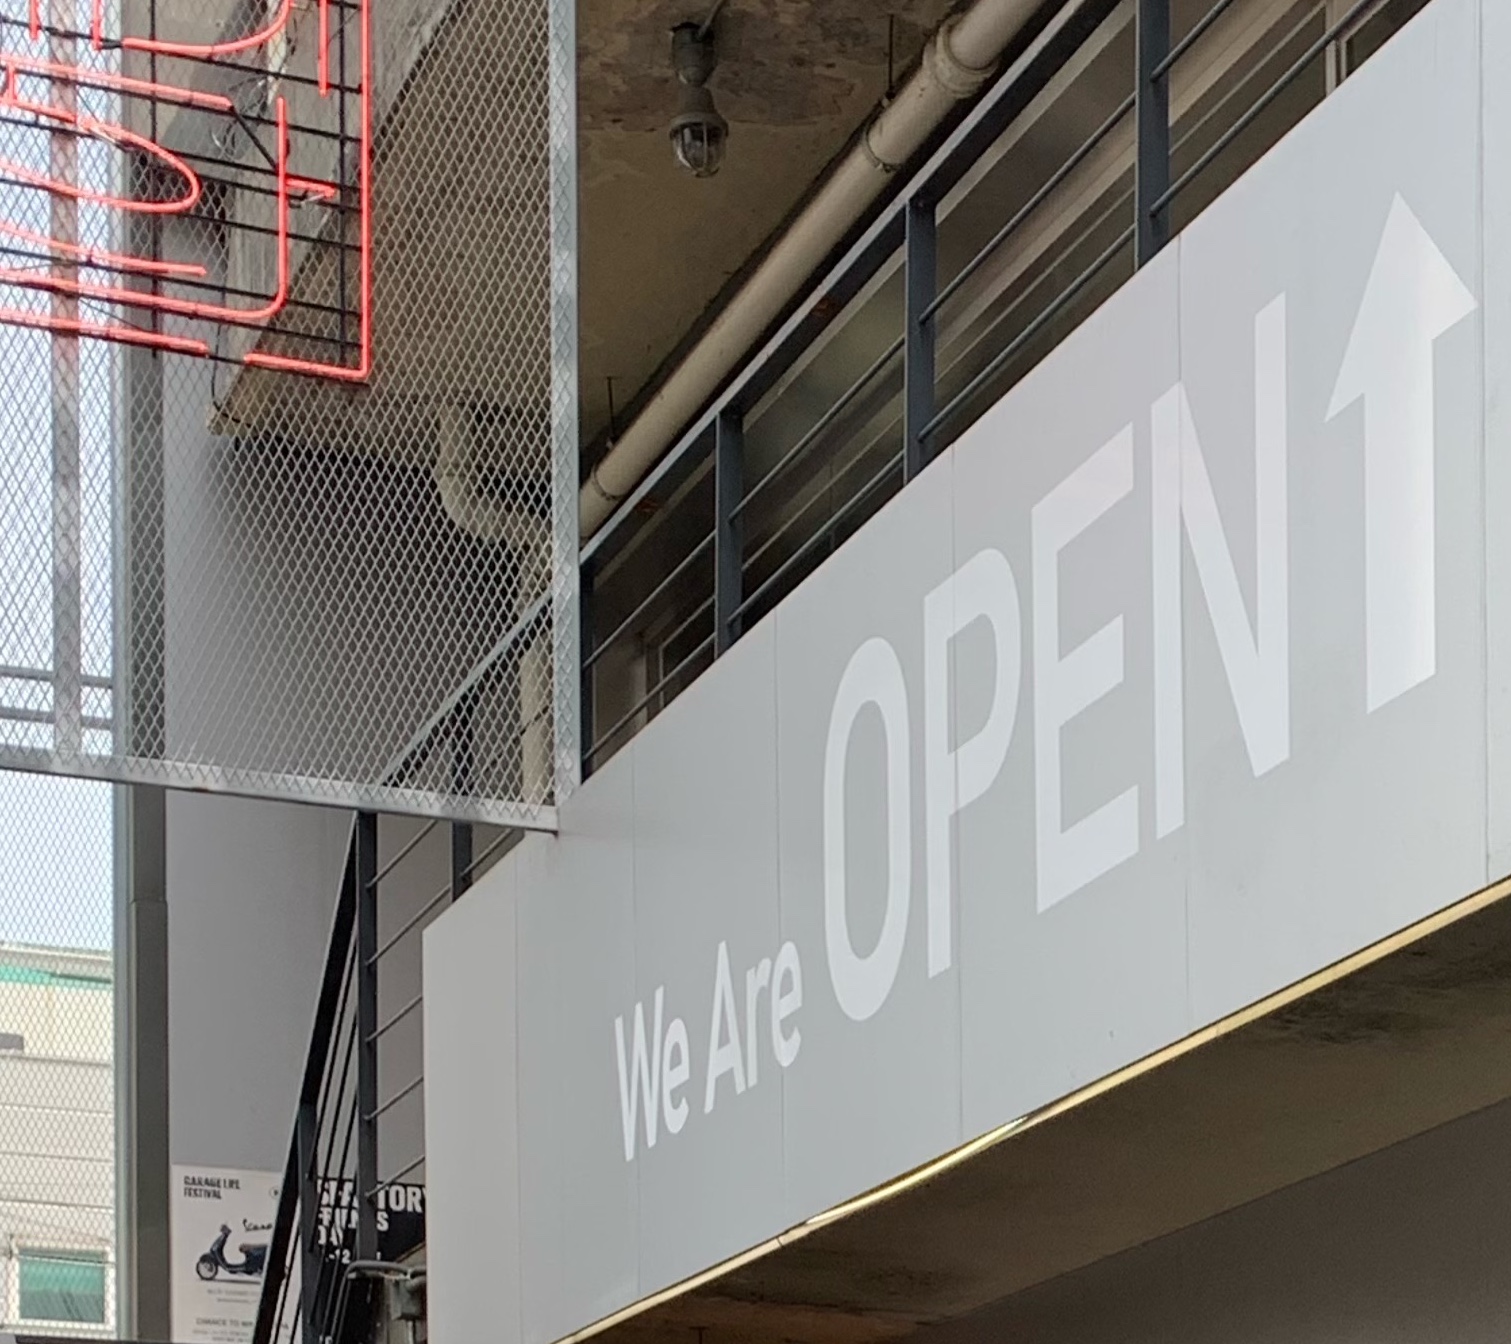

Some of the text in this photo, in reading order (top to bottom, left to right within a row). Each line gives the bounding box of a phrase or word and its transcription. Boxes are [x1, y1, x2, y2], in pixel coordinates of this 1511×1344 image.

[615, 291, 1292, 1162] We Are OPEN
[183, 1187, 222, 1200] FESTIVAL
